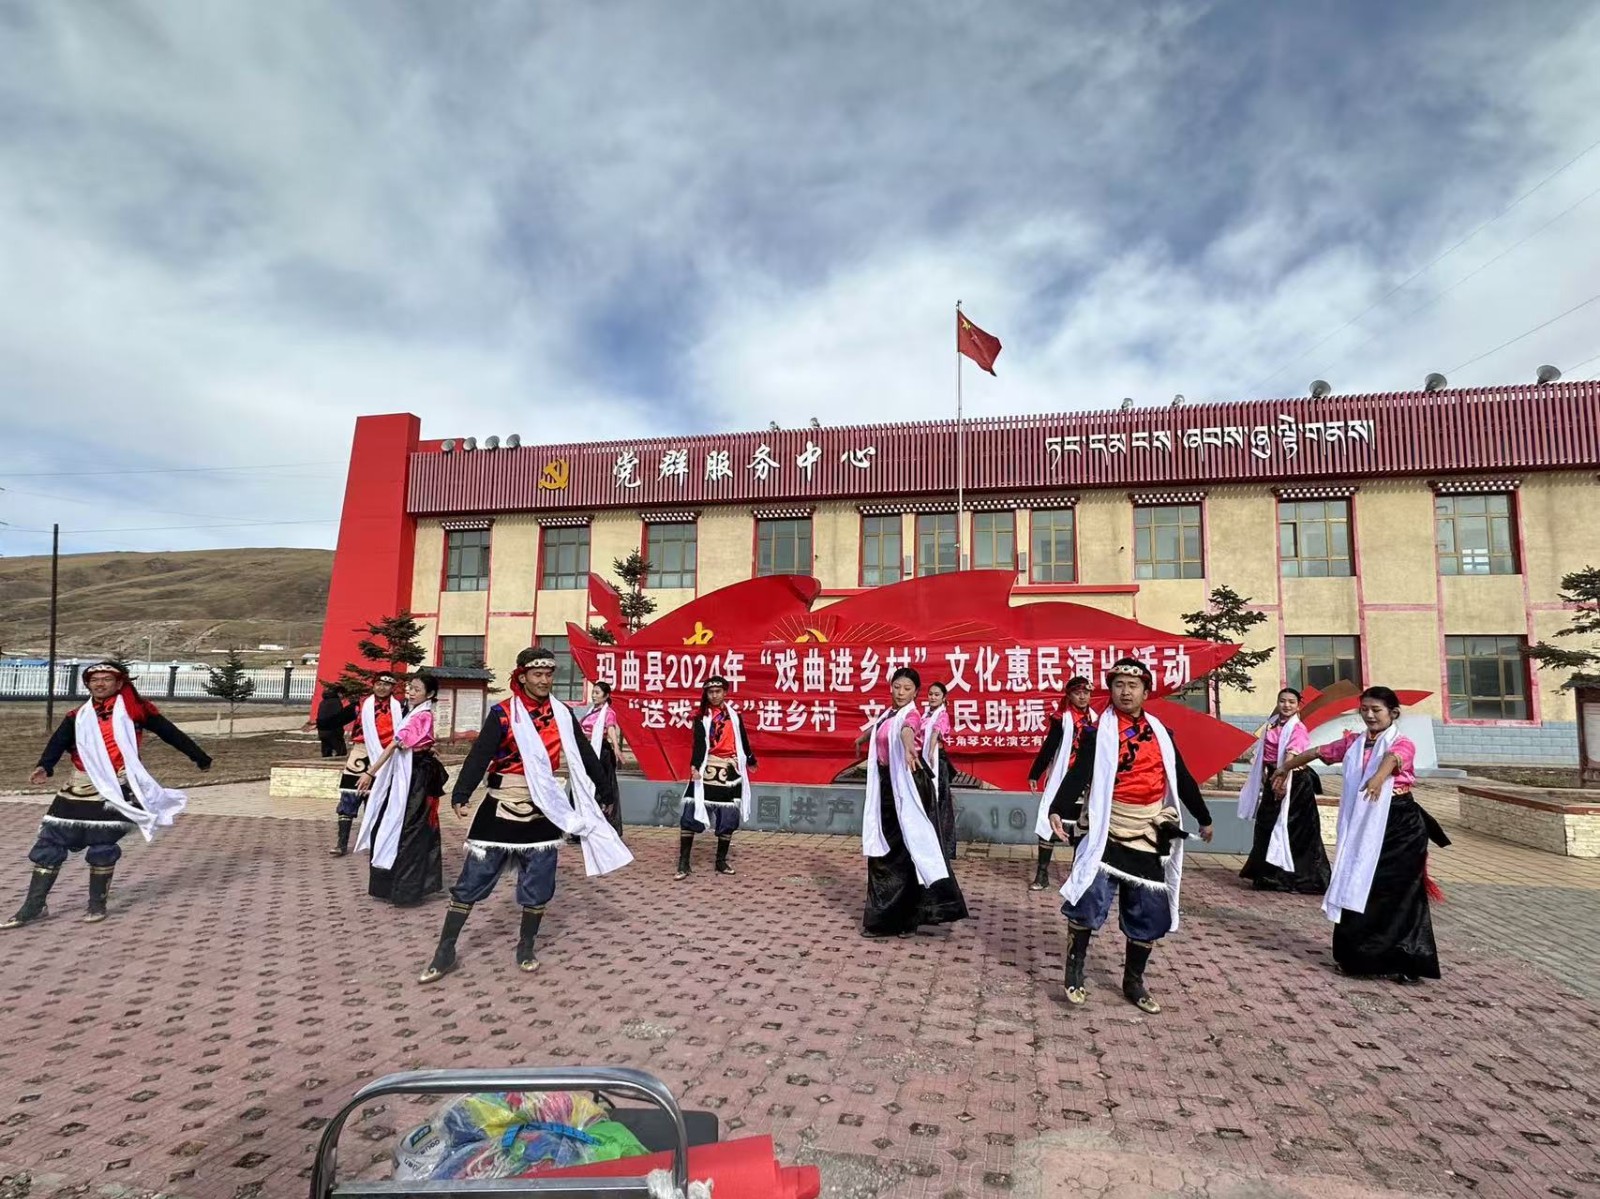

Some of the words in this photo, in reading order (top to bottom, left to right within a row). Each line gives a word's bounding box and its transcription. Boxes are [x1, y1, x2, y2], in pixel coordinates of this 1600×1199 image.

[612, 441, 876, 488] 党群服务中心
[596, 650, 746, 693] 玛曲县2024年
[628, 698, 837, 733] “送戏”进乡村
